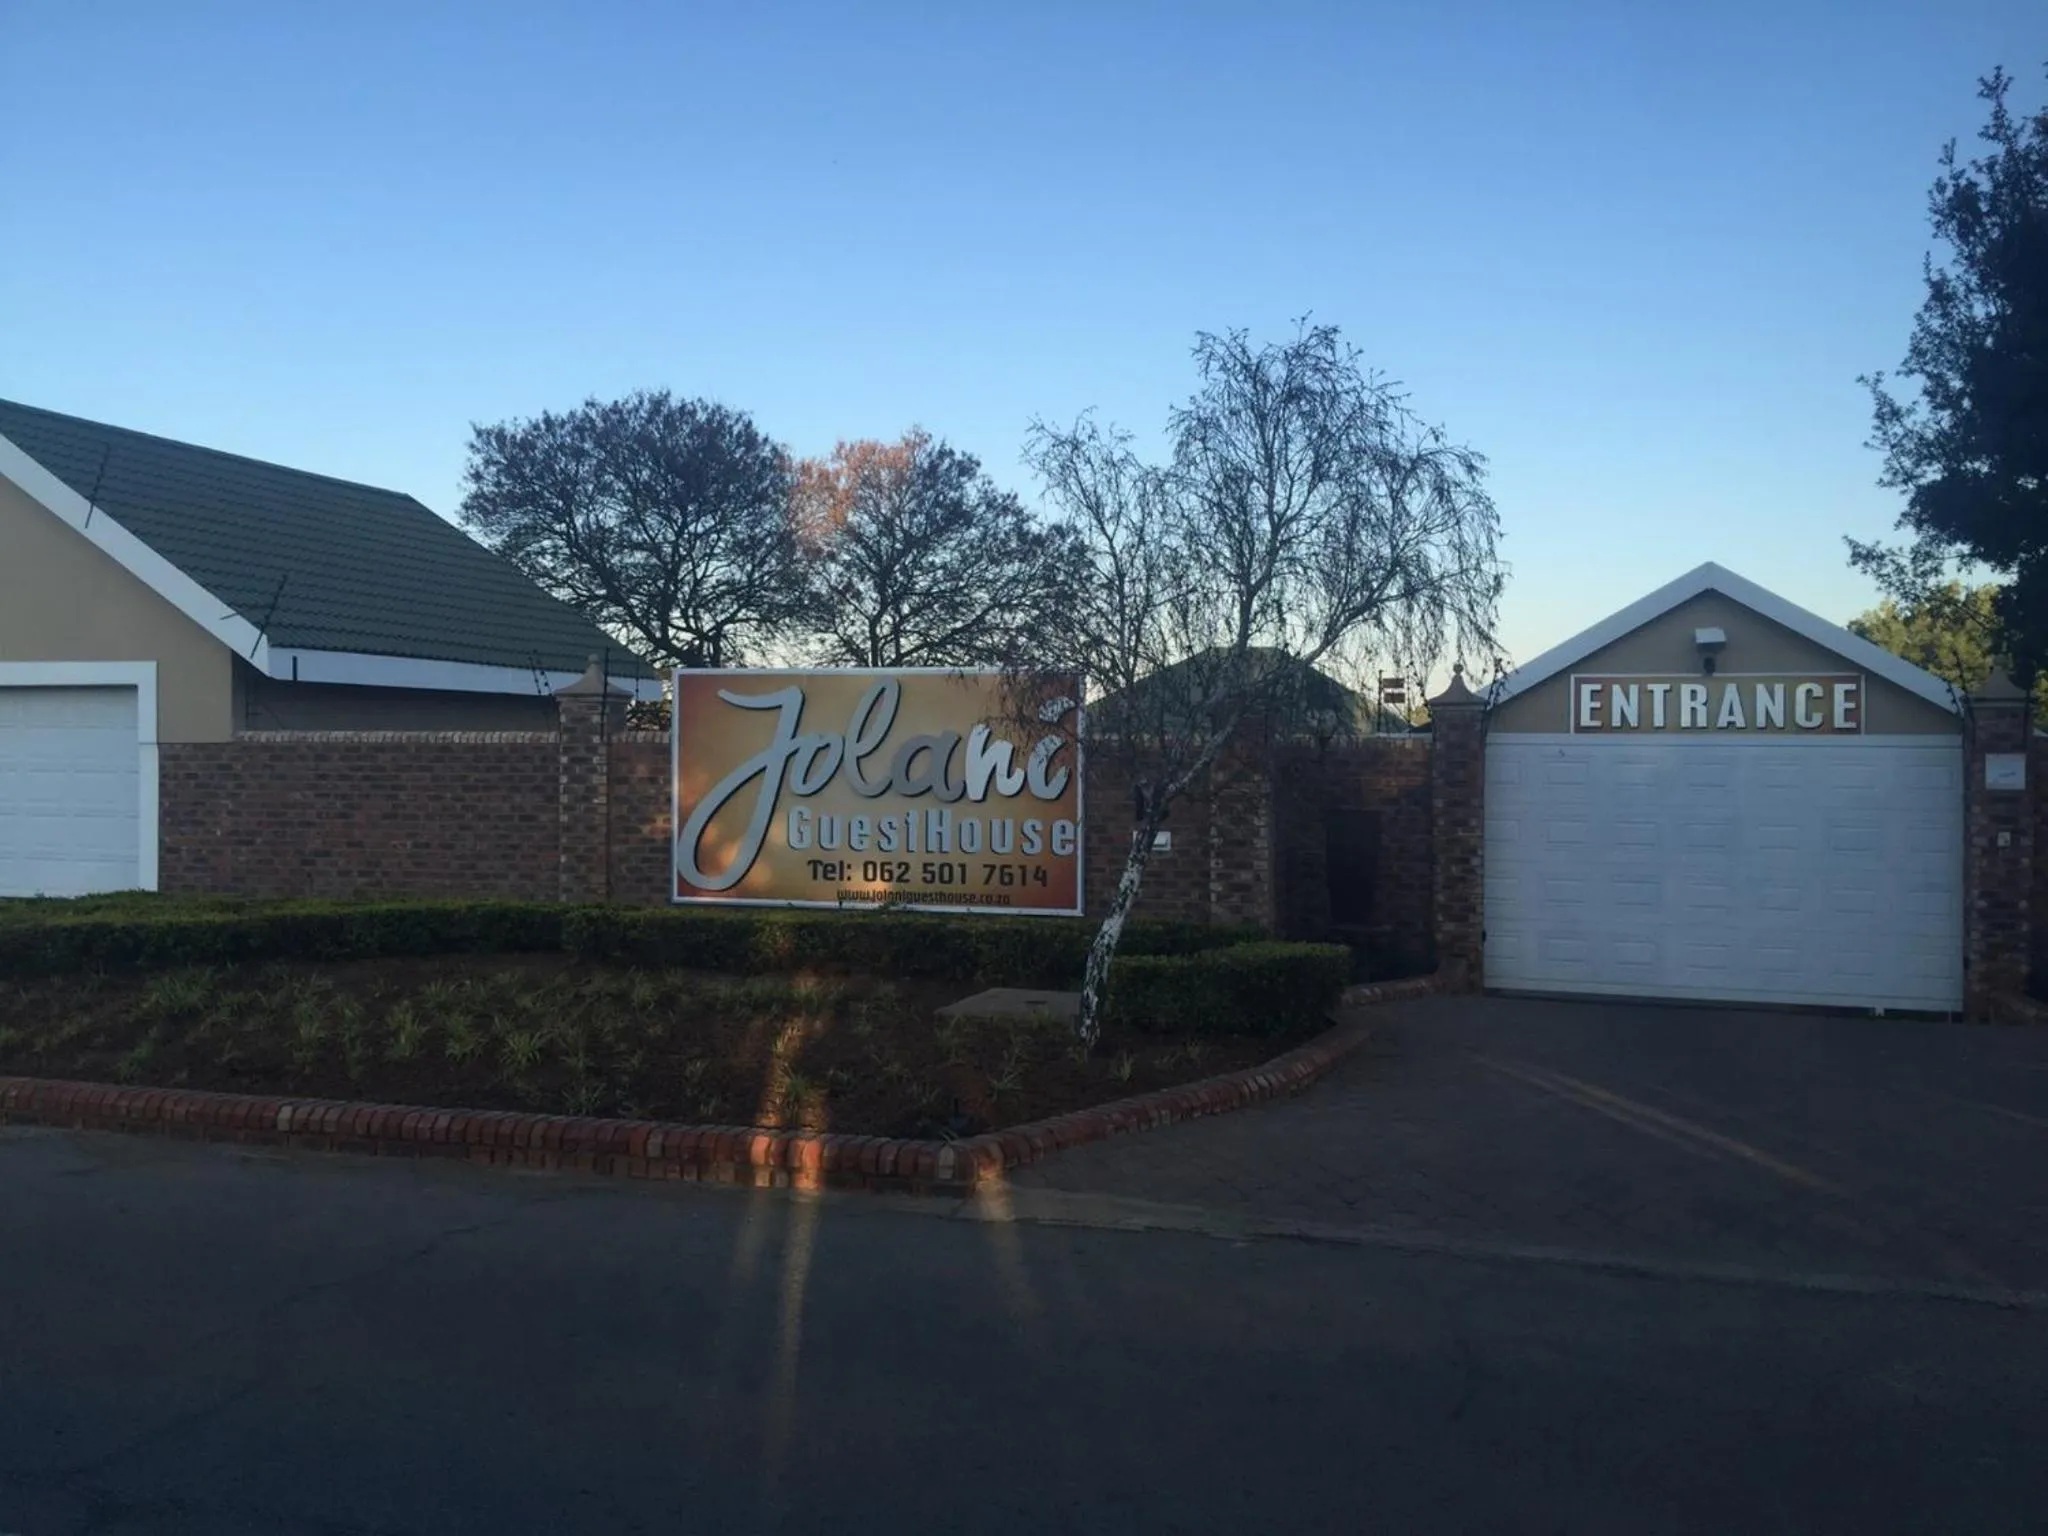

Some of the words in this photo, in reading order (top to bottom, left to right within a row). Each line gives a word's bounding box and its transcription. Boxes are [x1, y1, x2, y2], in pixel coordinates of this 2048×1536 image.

[1580, 683, 1858, 730] ENTRANCE
[678, 676, 1076, 892] Jolani
[787, 805, 1076, 855] GuestHouse
[807, 859, 851, 881] Tel:
[863, 860, 910, 884] 062
[922, 862, 967, 885] 501
[983, 863, 1048, 888] 7614
